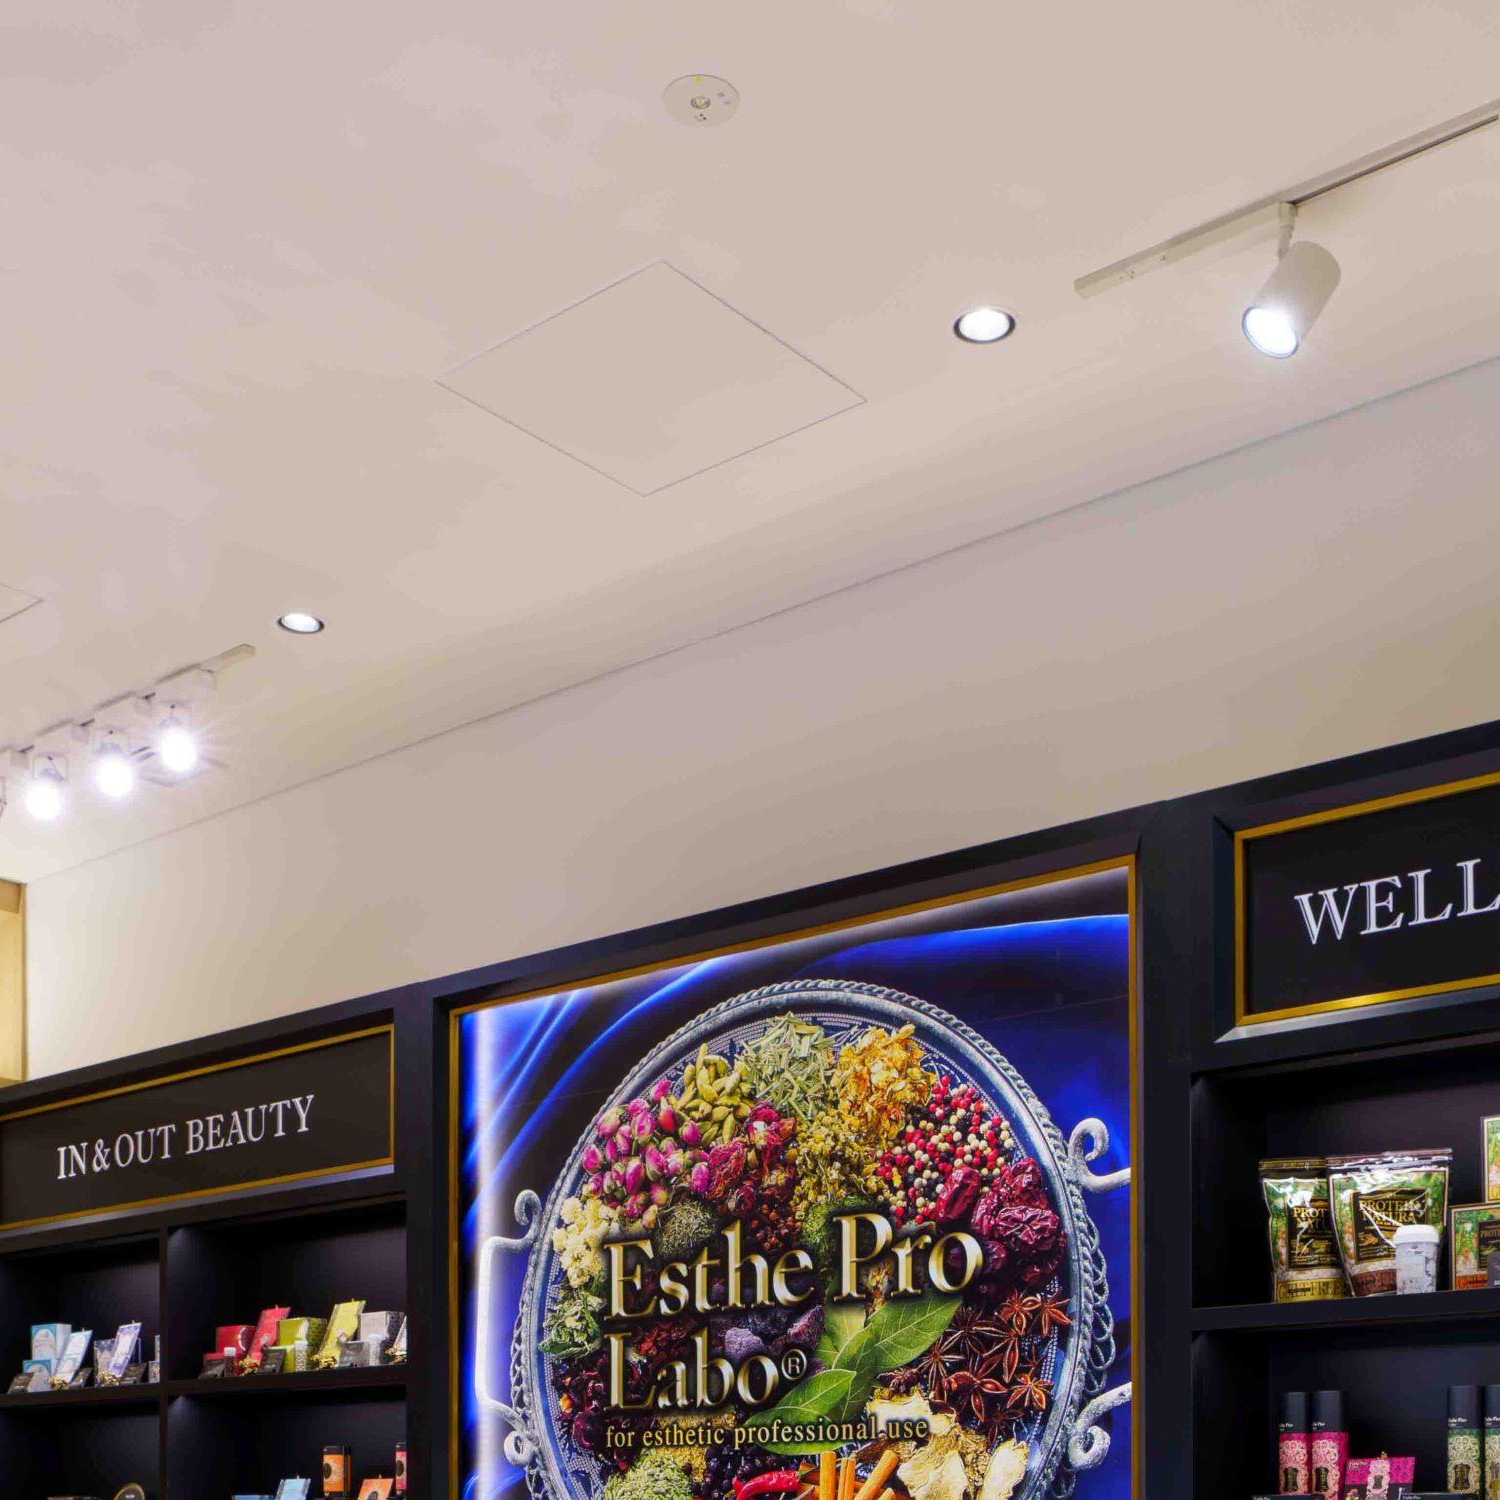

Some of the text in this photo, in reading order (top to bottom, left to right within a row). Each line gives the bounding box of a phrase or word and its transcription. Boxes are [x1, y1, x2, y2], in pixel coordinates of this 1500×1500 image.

[57, 1095, 315, 1180] IN&OUT BEAUTY
[601, 1211, 984, 1322] Esthe Pro
[606, 1417, 930, 1453] for esthetic professional use
